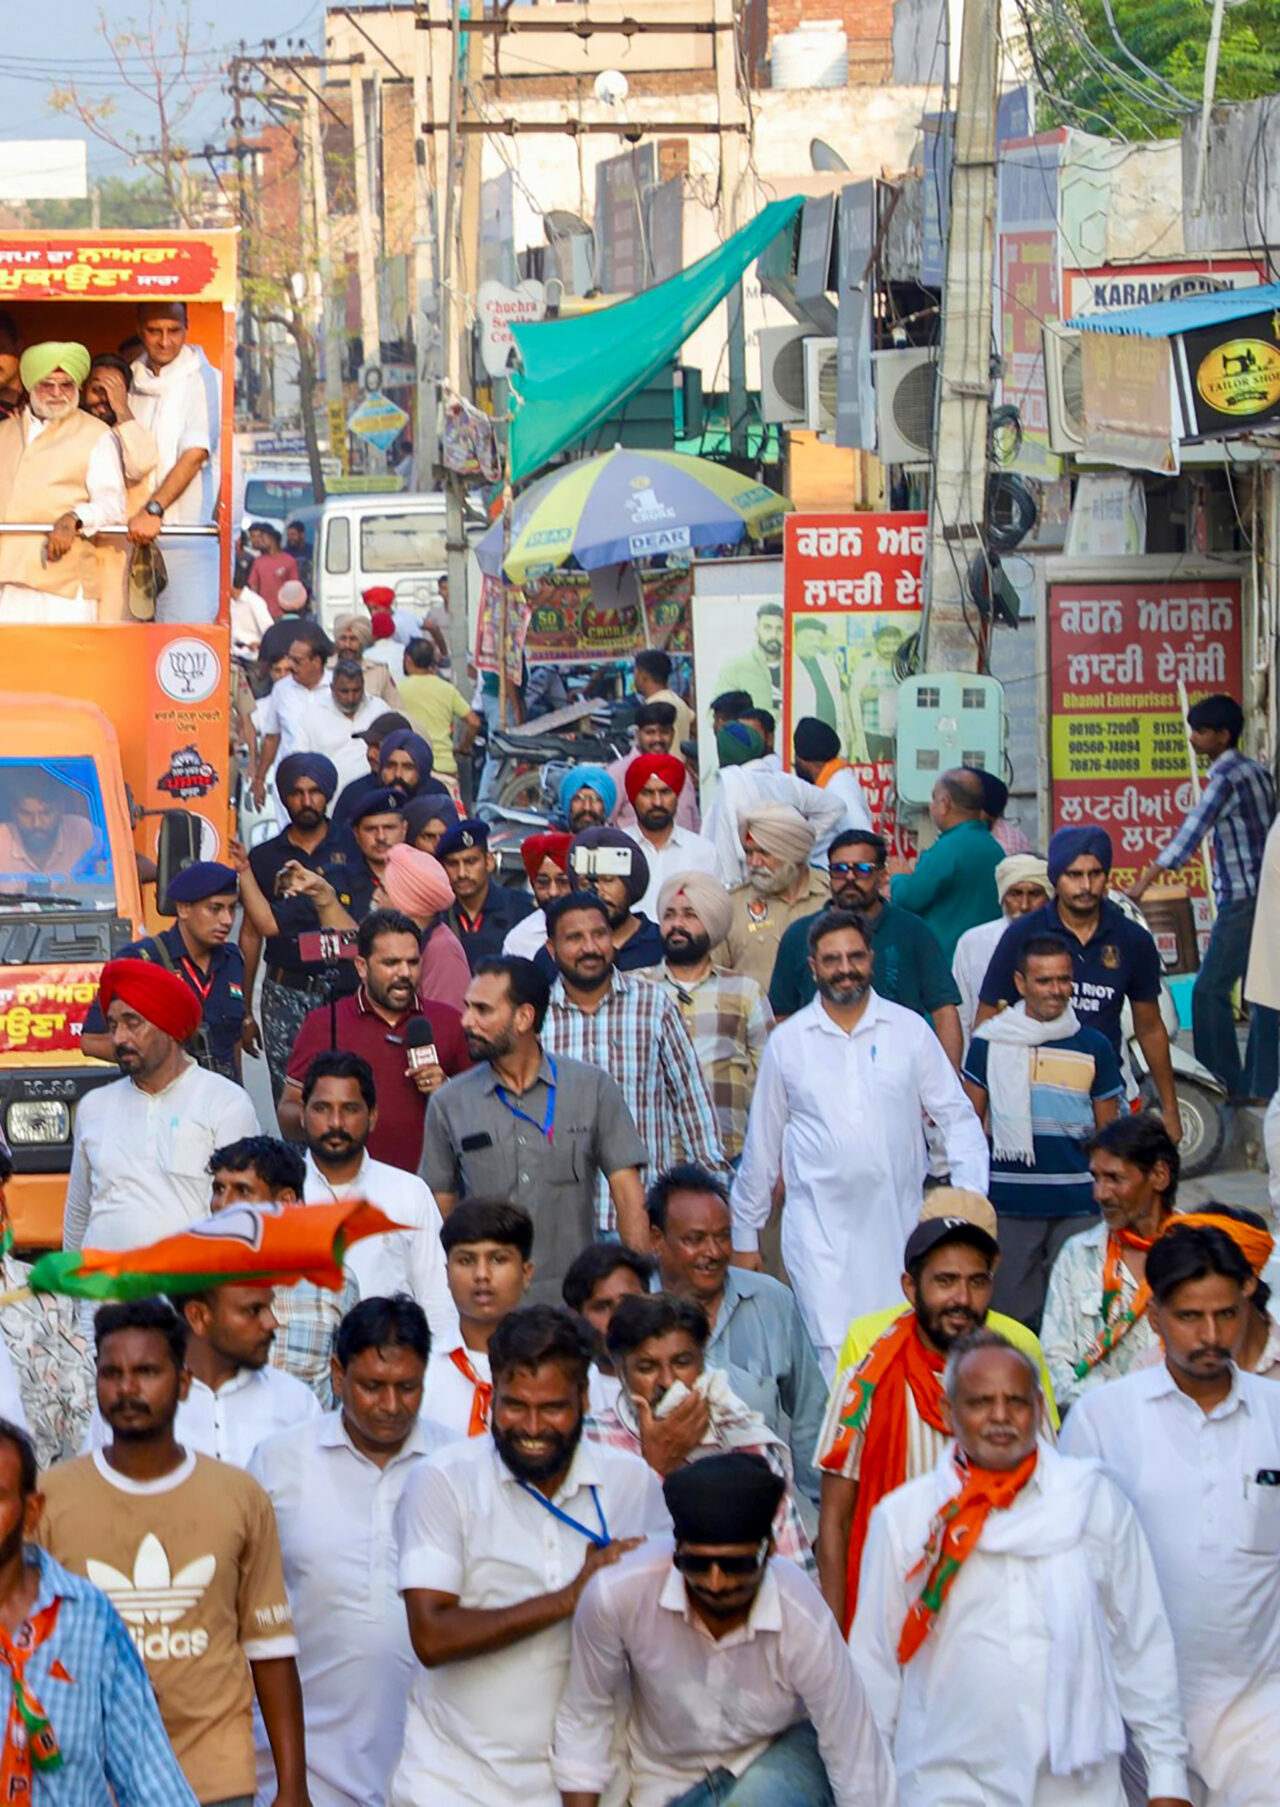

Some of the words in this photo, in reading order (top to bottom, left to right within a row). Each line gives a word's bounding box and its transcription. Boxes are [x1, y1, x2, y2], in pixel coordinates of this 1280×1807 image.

[46, 250, 73, 263] ਦਾ
[76, 247, 178, 264] ਨਾਅਰਾ
[1094, 282, 1163, 307] KARAN
[632, 533, 685, 549] DEAR
[796, 527, 863, 558] ਕਰਨ
[803, 570, 883, 606] ਲਾਟਰੀ
[1059, 599, 1124, 634] ਕਰਨ
[1137, 597, 1234, 641] ਅਰਜੁਨ
[1068, 643, 1144, 685] ਲਾਟਰੀ
[1062, 691, 1106, 708] Bhanot
[1108, 690, 1175, 708] Enterprises
[1082, 982, 1115, 1000] RIOT
[128, 1624, 209, 1661] idas
